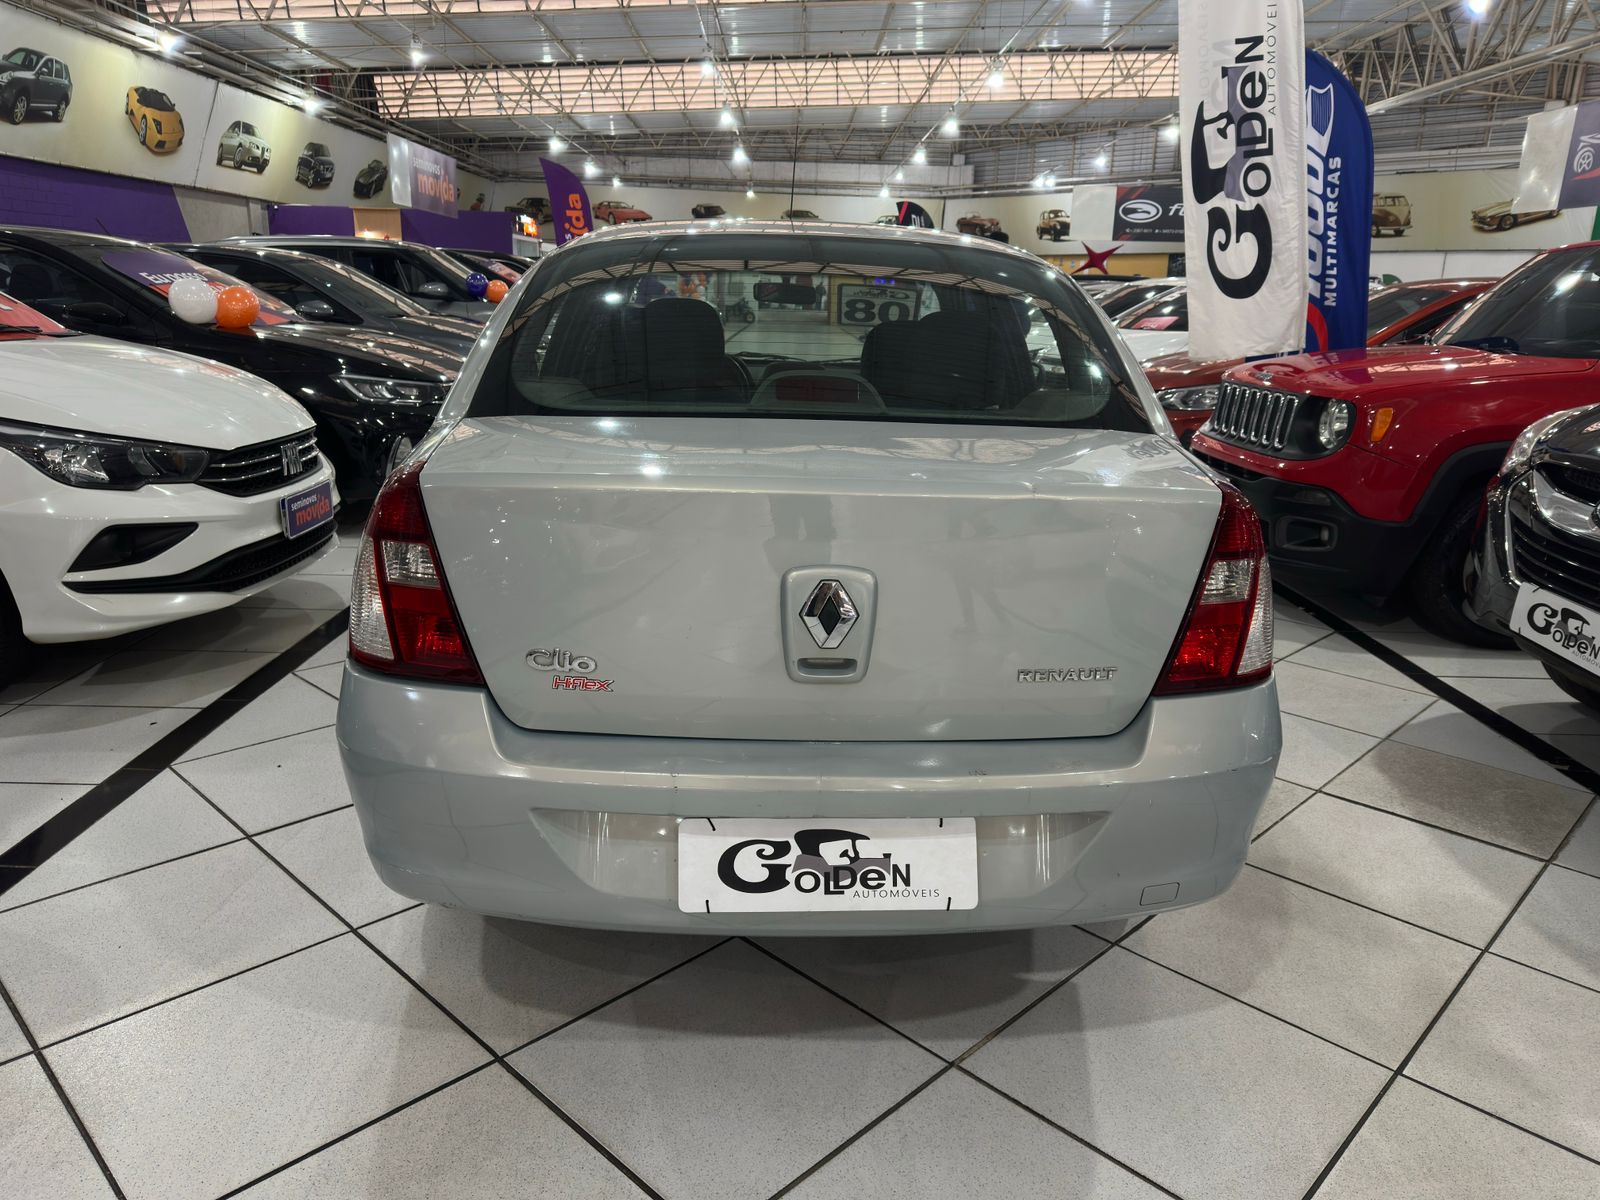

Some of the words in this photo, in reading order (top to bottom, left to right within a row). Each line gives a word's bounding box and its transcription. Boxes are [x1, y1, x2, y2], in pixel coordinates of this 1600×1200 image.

[417, 168, 455, 205] movida
[564, 193, 590, 236] ida
[1323, 156, 1342, 307] MULTIMARCAS
[295, 495, 331, 526] movida
[525, 647, 598, 673] Clio
[1017, 666, 1118, 682] RENAULT
[853, 887, 940, 898] AUTOMÓVEIS
